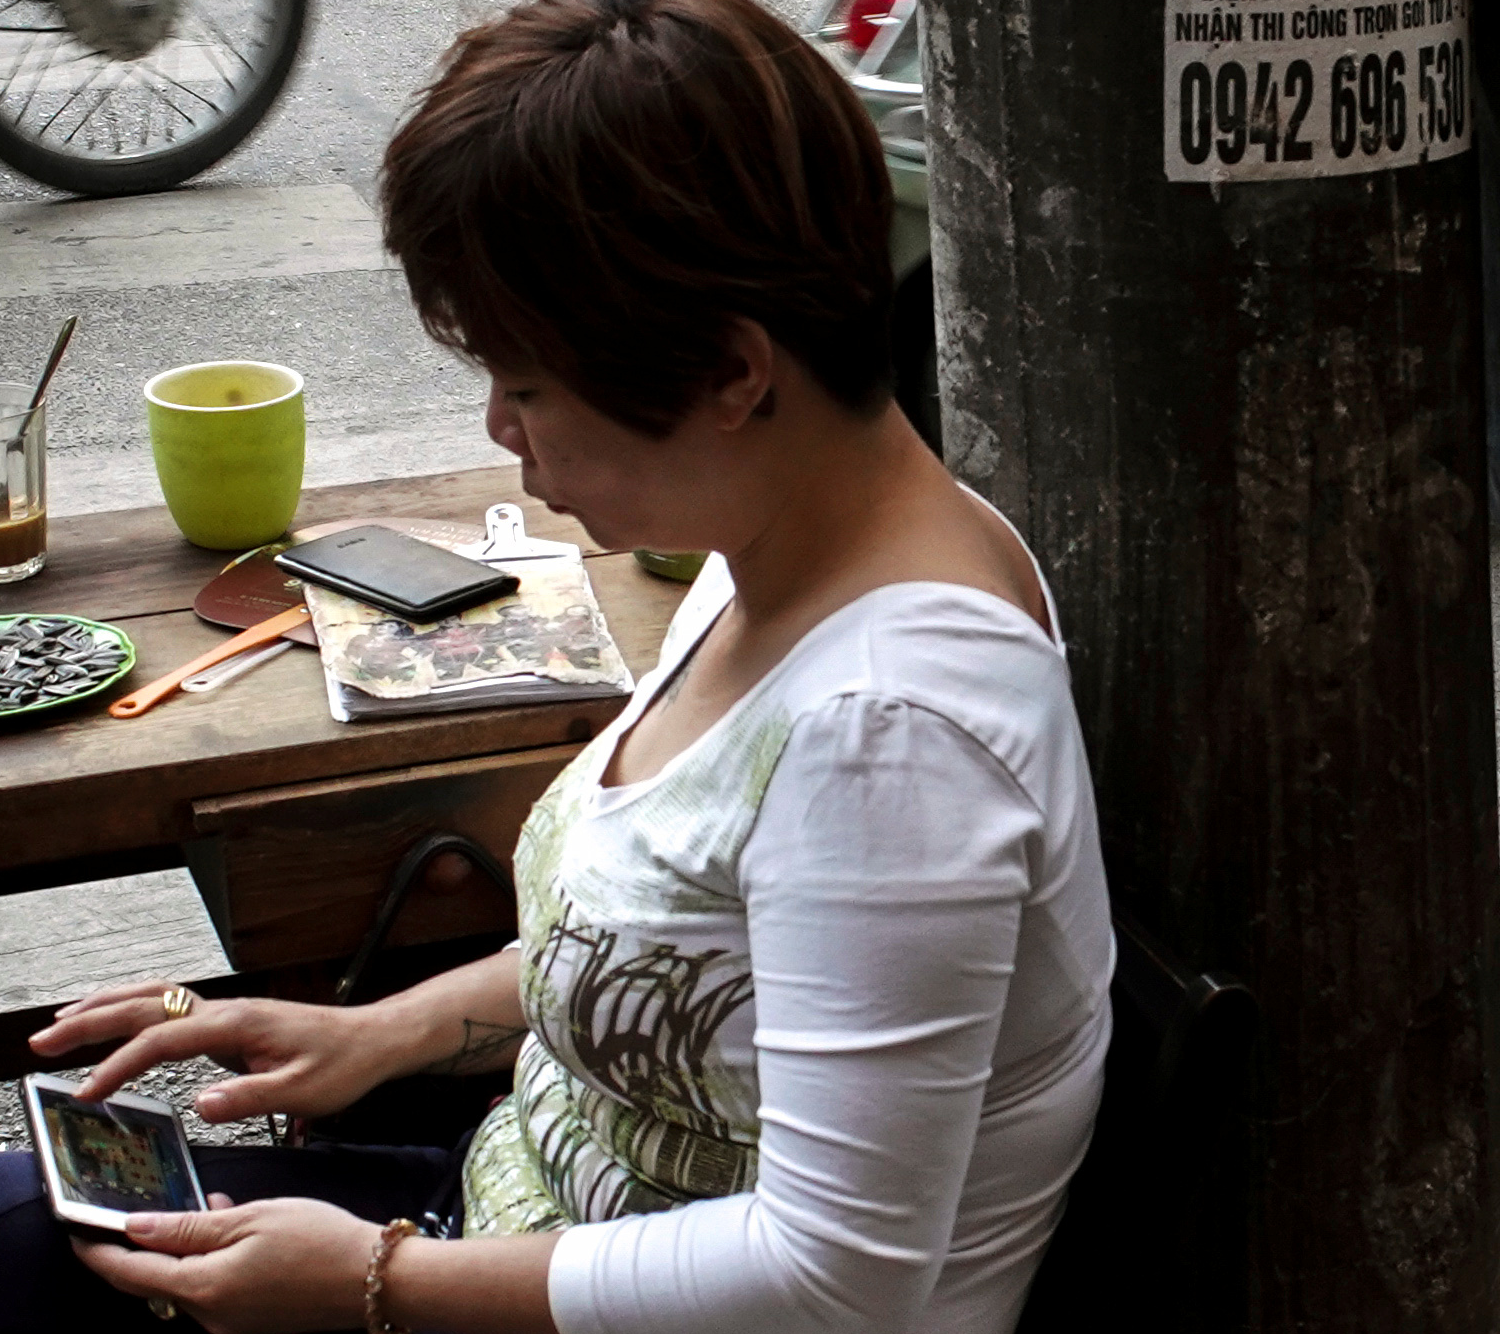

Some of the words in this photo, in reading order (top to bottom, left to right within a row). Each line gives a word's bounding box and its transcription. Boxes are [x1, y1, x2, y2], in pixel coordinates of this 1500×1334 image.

[1174, 7, 1243, 50] NHẬN
[1249, 12, 1285, 42] THI
[1290, 4, 1348, 41] CÔNG
[1352, 2, 1398, 40] TRỌN
[1179, 59, 1314, 166] 0942
[1330, 49, 1407, 160] 696
[1417, 37, 1465, 144] 530
